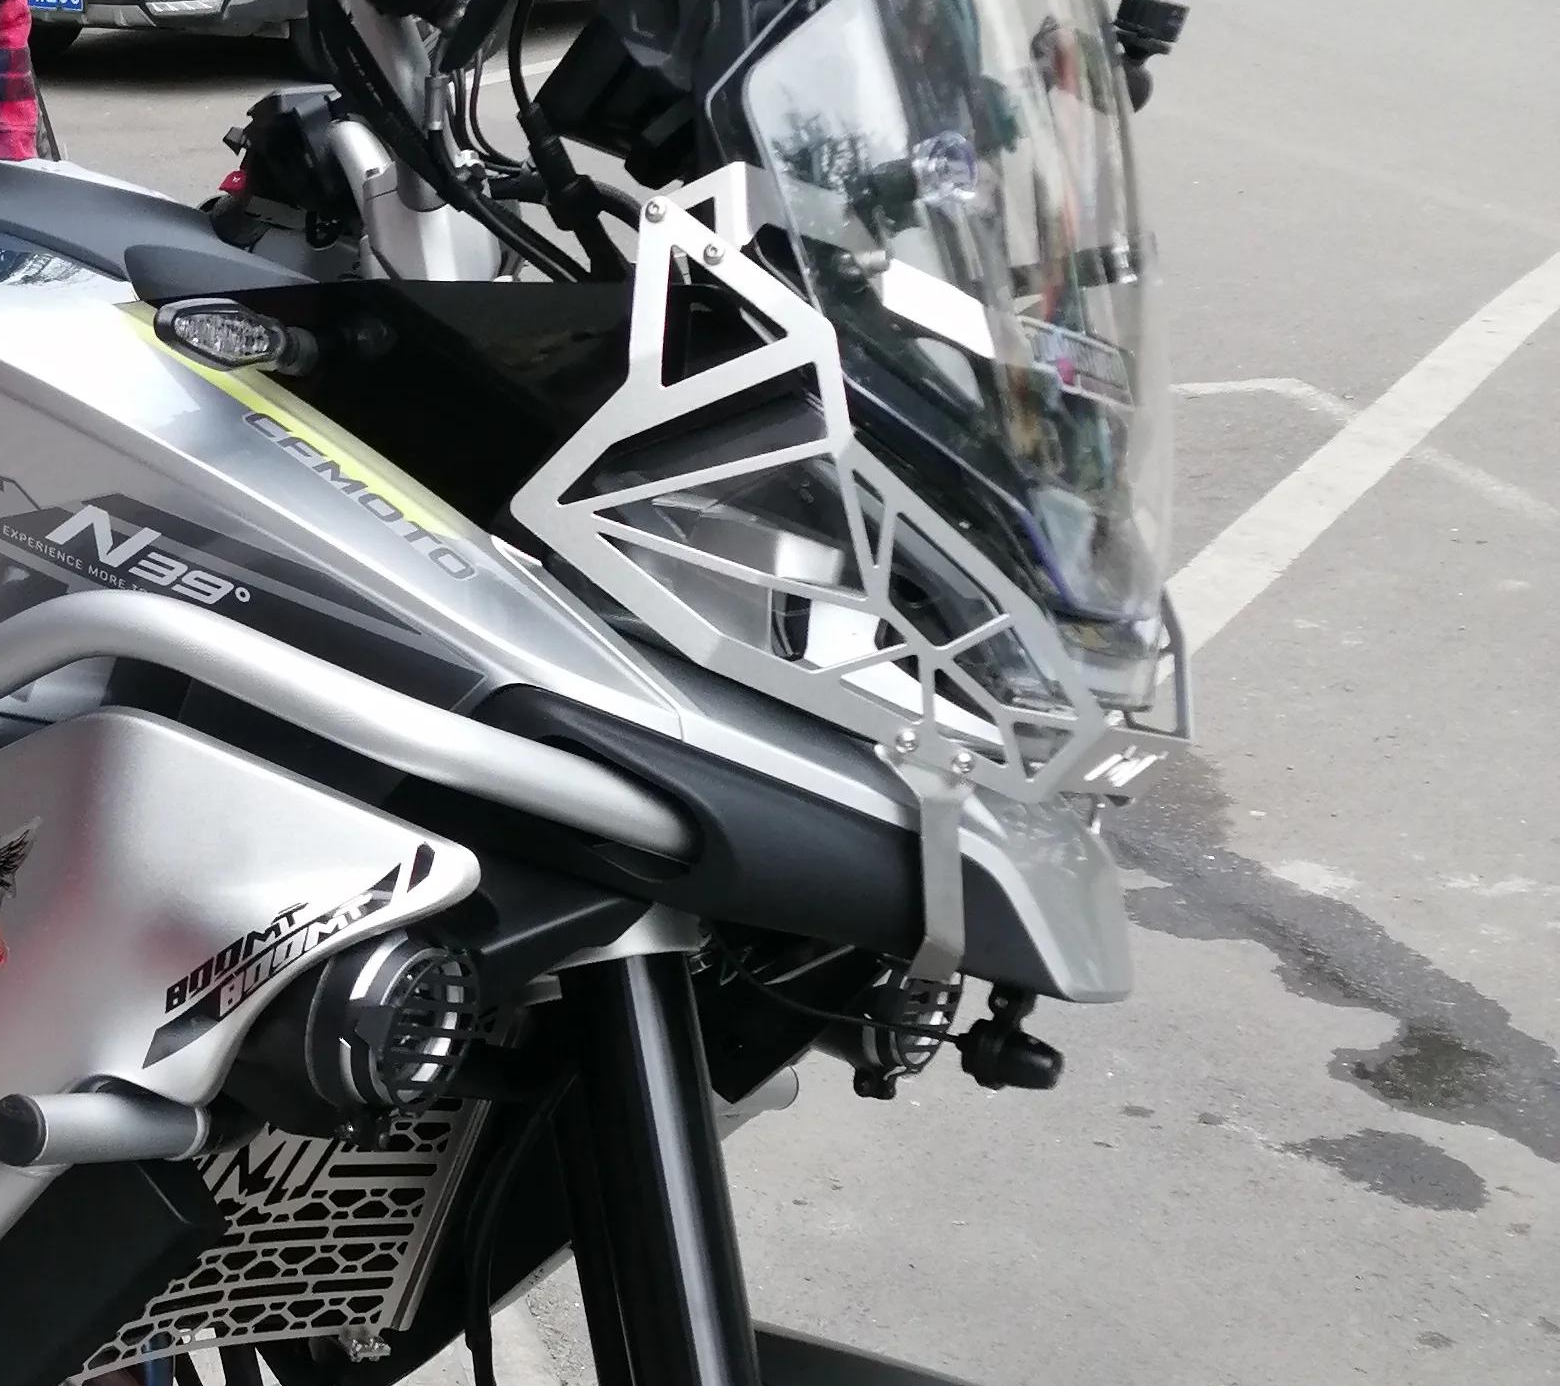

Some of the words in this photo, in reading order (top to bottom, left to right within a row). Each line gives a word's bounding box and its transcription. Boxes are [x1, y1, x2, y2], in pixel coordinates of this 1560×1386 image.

[243, 412, 477, 580] CFMOTO
[2, 525, 83, 570] EXPERIENCE
[88, 564, 127, 590] MORE
[165, 902, 309, 1014] 800MT
[219, 892, 373, 1017] 800MT
